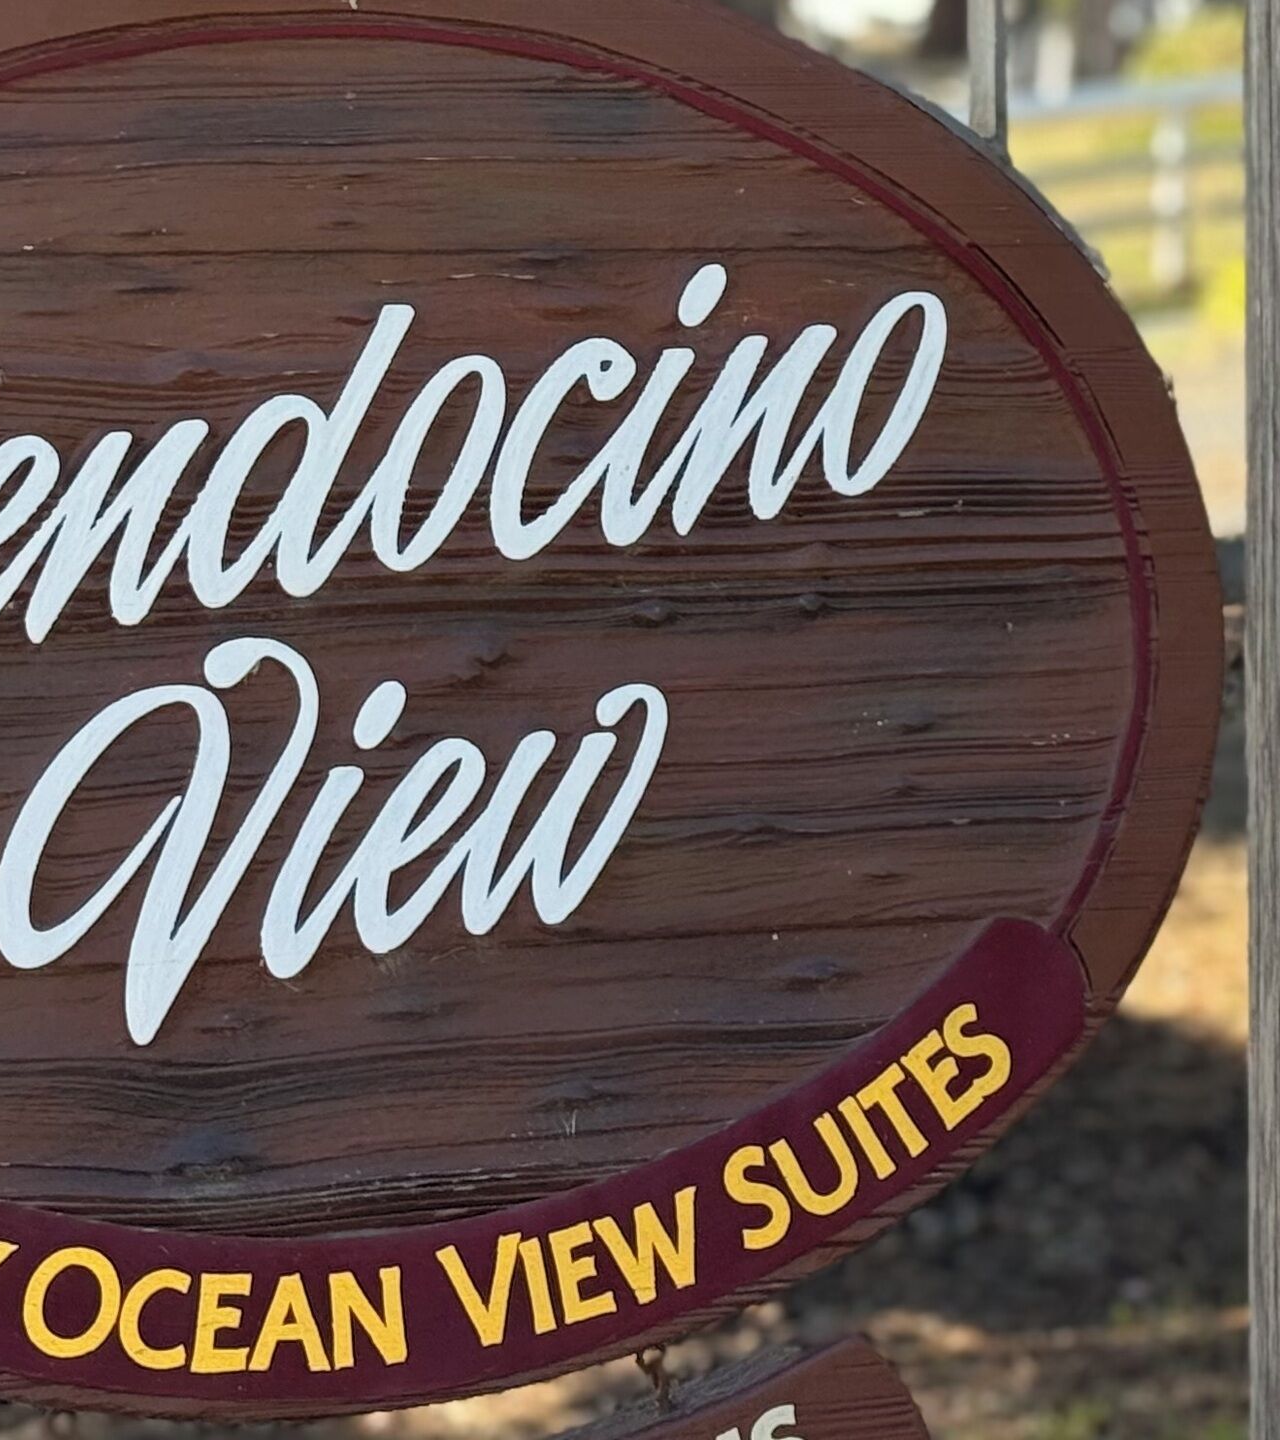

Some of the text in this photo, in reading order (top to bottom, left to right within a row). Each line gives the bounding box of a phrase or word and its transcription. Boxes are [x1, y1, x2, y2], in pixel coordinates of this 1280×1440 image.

[23, 1247, 408, 1372] OCEAN
[435, 1187, 697, 1347] VIEW
[723, 1004, 1011, 1251] SUITES
